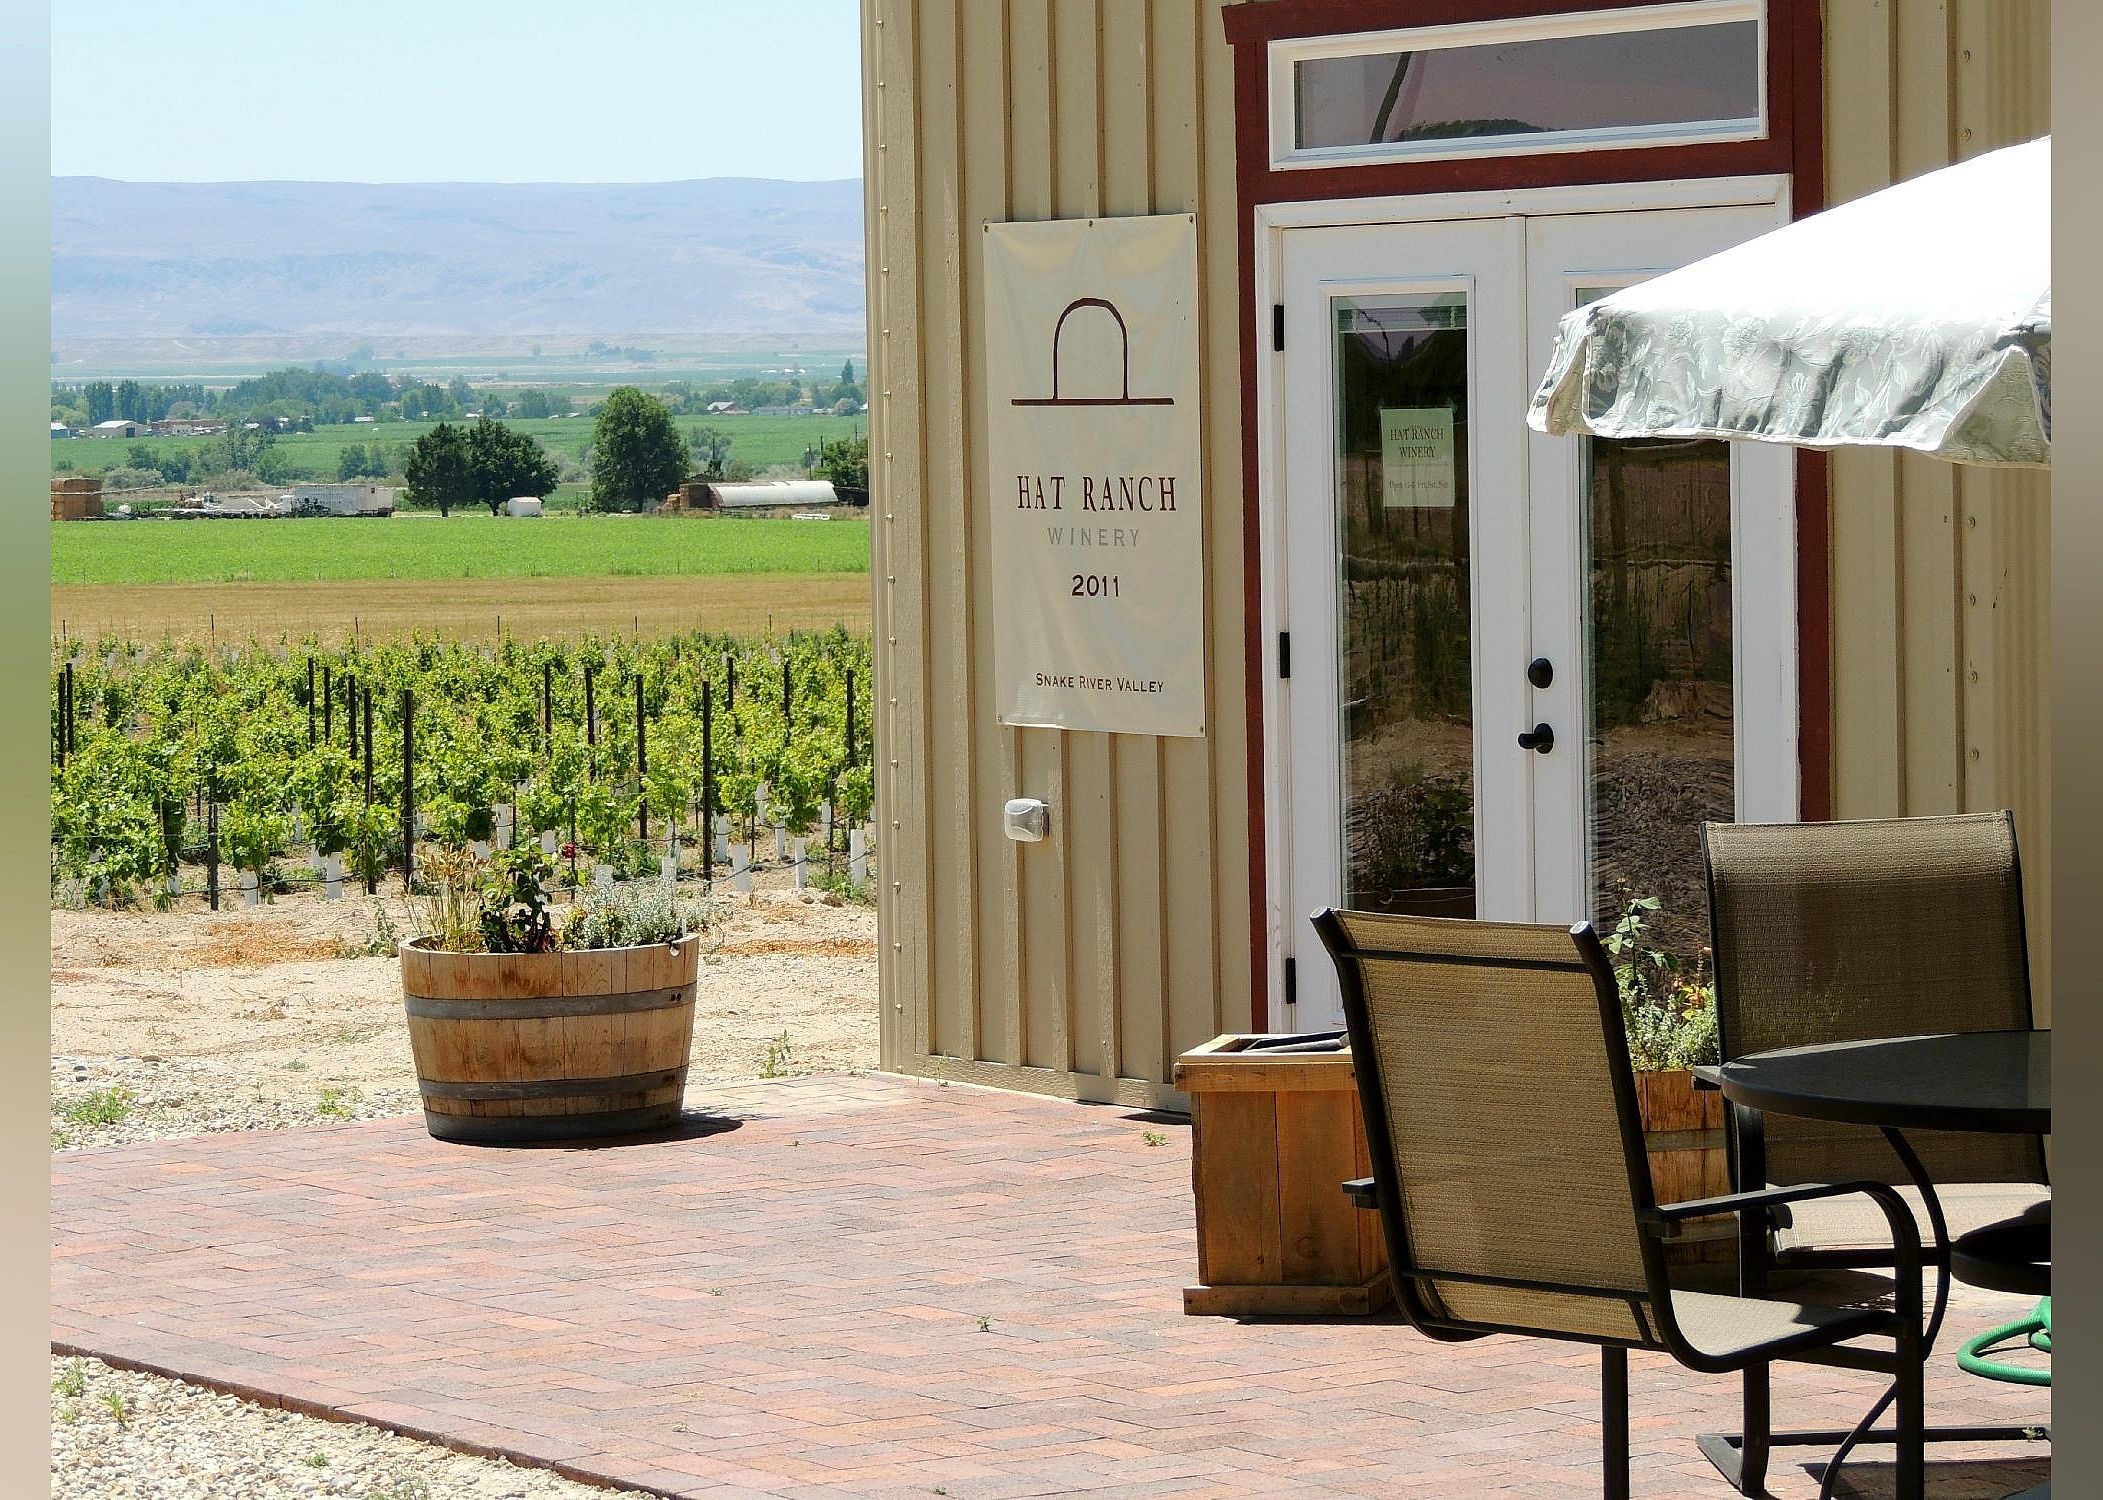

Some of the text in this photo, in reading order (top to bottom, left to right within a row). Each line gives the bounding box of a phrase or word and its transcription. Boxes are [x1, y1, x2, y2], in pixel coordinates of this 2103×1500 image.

[1390, 427, 1444, 441] HAT RANCH
[1399, 446, 1436, 459] WINERY
[1017, 475, 1177, 512] HAT RANCH
[1047, 527, 1140, 547] WINERY
[1071, 574, 1119, 597] 2011
